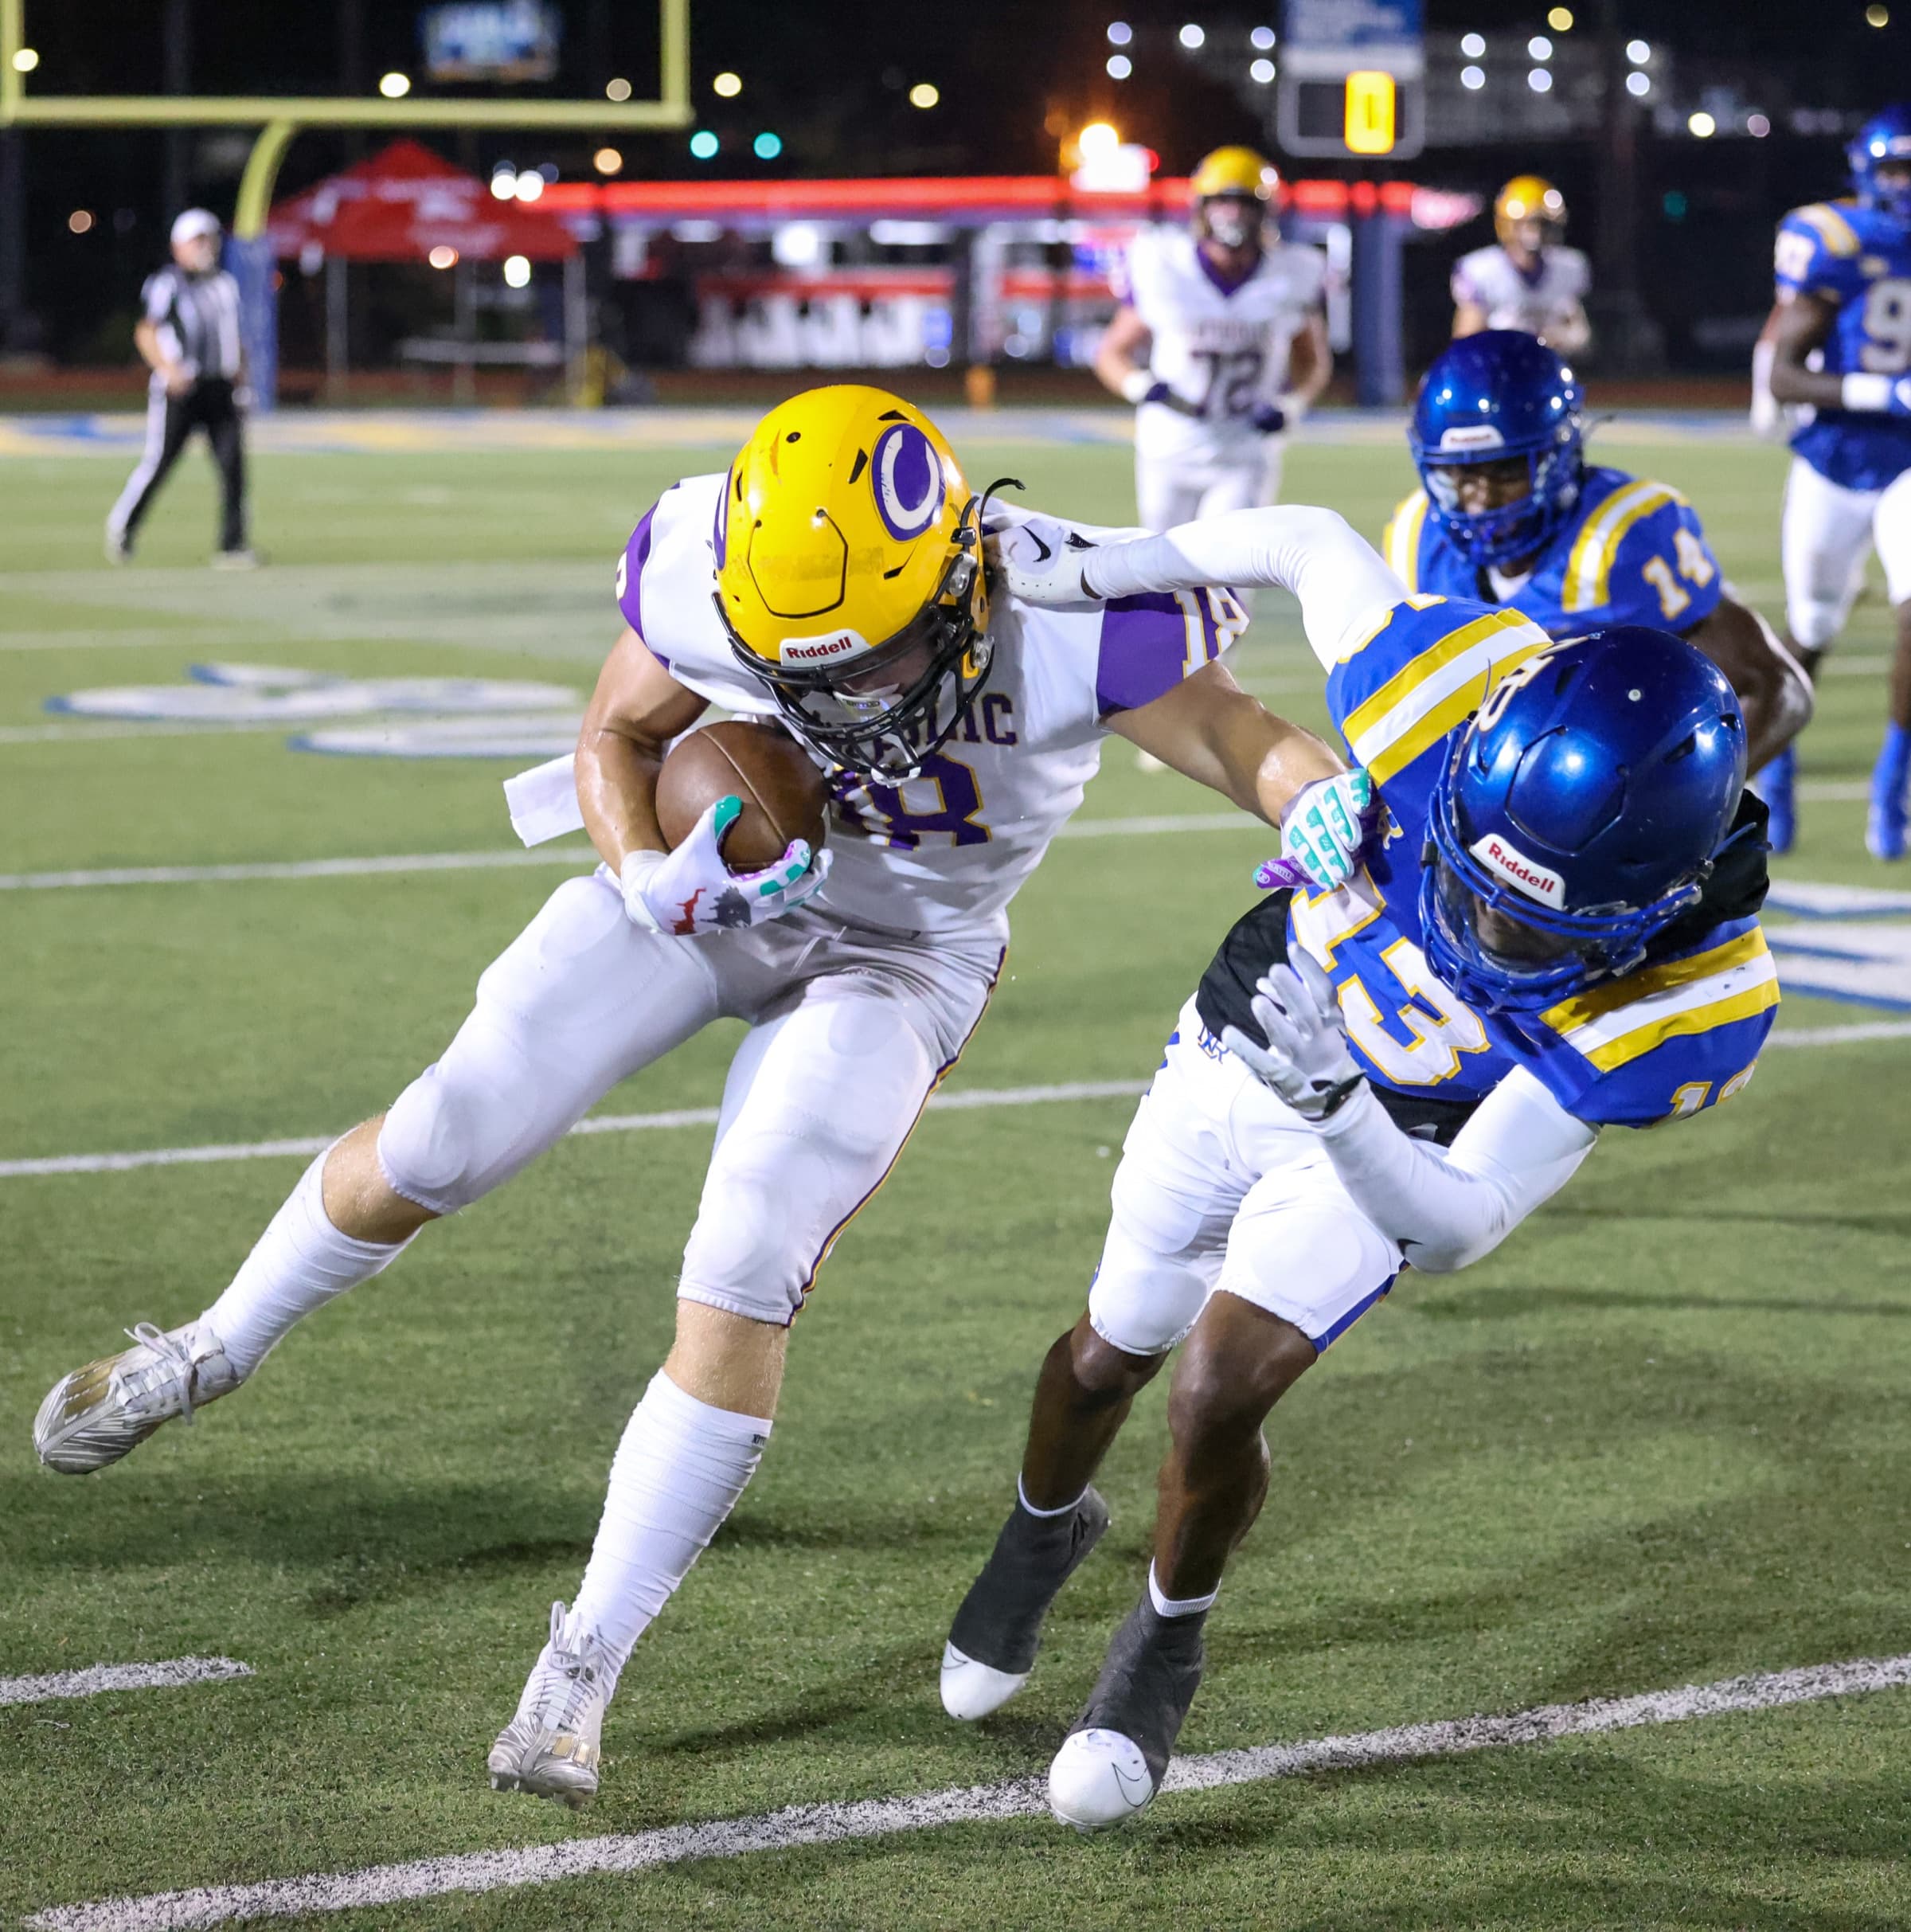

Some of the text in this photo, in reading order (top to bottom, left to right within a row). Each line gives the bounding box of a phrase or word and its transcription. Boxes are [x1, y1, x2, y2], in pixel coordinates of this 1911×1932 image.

[1343, 70, 1395, 154] 0
[1643, 526, 1714, 620] 14
[785, 636, 853, 659] Riddell
[1173, 585, 1251, 680] 18
[1488, 842, 1555, 893] Riddell
[1290, 863, 1492, 1085] 13
